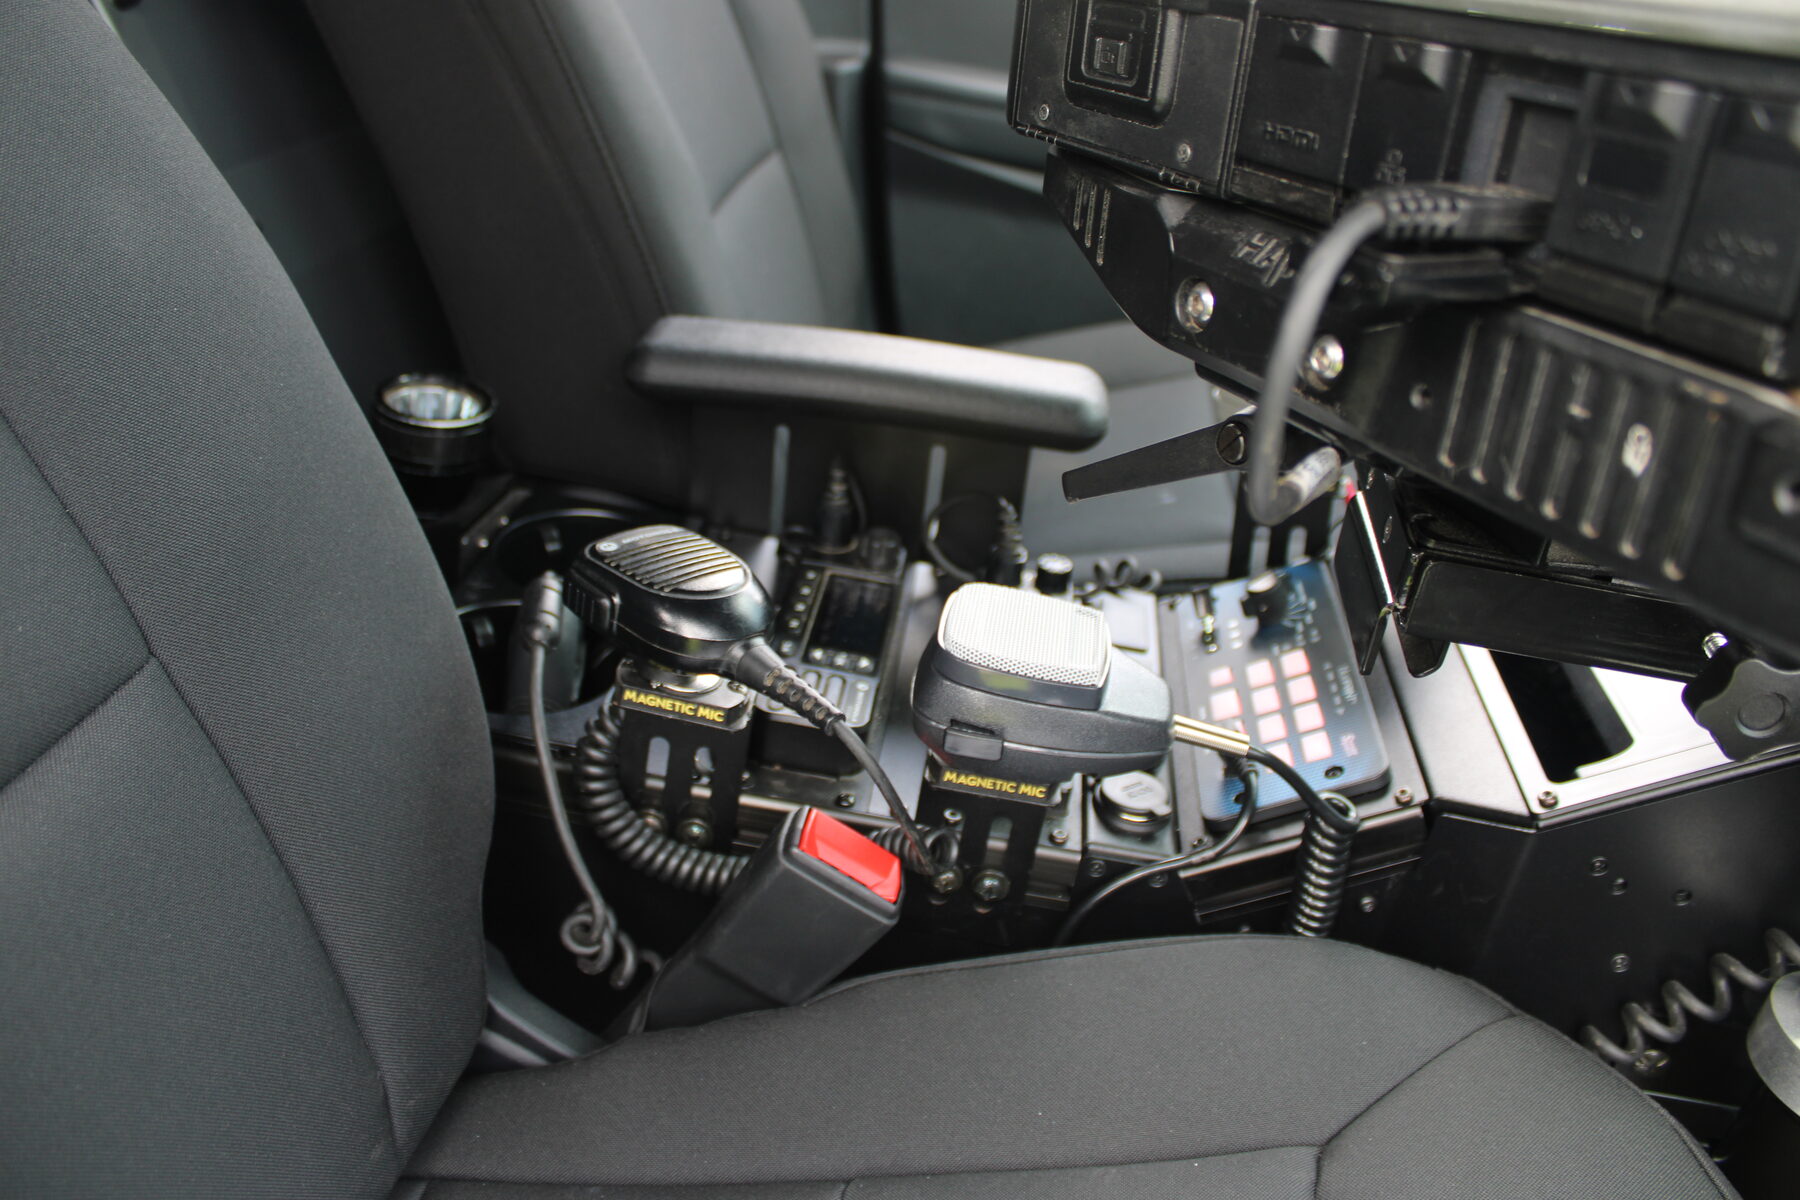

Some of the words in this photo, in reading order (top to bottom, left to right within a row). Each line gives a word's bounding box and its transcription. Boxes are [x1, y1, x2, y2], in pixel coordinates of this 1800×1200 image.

[623, 689, 695, 716] MAGNETIC
[697, 706, 725, 722] MIC
[943, 771, 1017, 793] MAGNETIC
[1018, 784, 1047, 798] MIC
